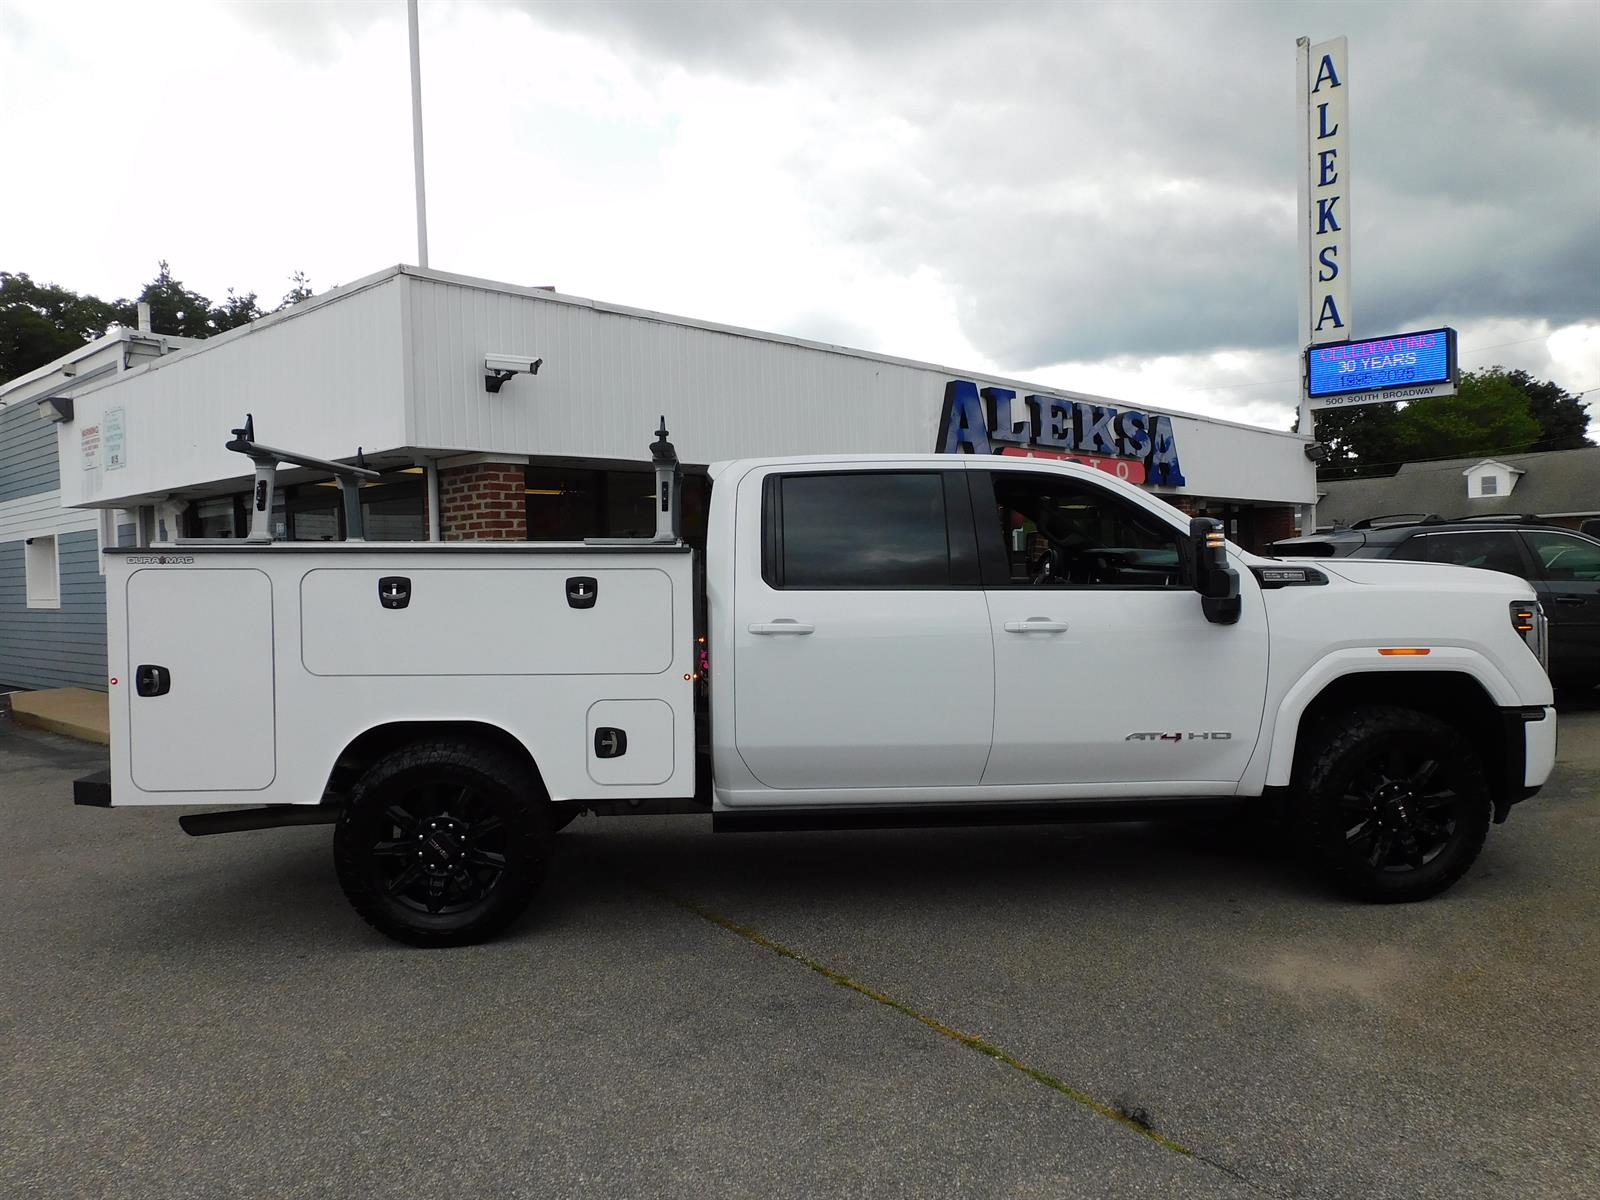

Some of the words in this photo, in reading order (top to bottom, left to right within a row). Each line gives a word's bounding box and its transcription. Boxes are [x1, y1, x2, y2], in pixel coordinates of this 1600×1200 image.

[1312, 54, 1344, 331] ALEKSA
[1338, 360, 1357, 373] 30
[1361, 352, 1417, 370] YEARS
[1325, 397, 1344, 406] 500
[1347, 393, 1379, 404] SOUTH
[1382, 386, 1436, 400] BROADWAY
[935, 379, 1186, 487] ALEKSA
[1125, 731, 1182, 743] AT4
[1188, 732, 1232, 740] HD
